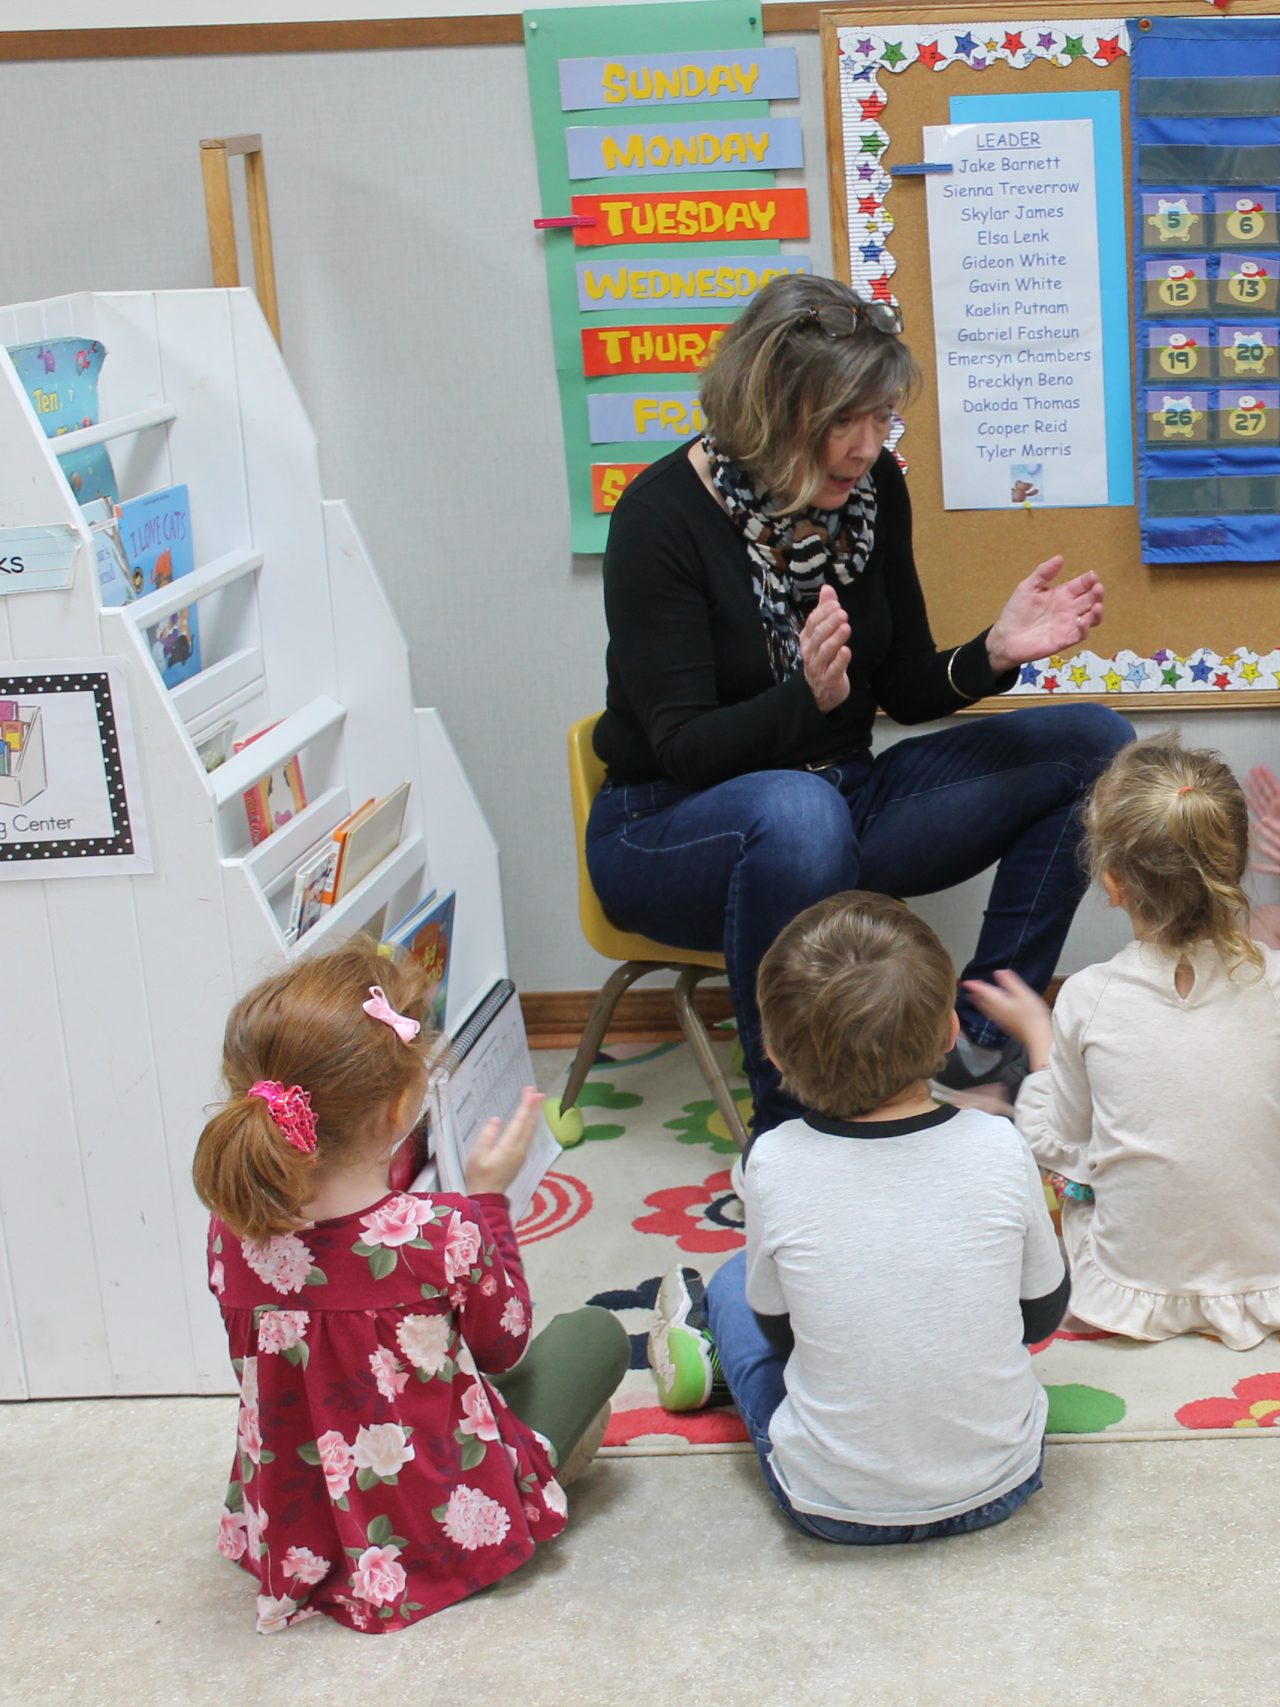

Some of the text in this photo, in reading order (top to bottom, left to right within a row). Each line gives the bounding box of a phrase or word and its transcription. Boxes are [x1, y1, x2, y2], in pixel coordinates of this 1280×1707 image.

[602, 63, 758, 103] SUNDAY
[977, 132, 1041, 149] LEADER
[601, 132, 769, 170] MONDAY
[959, 157, 1061, 174] Jake Barnett
[943, 182, 1080, 198] Sienna Treverrow
[600, 200, 776, 236] TUESDAY
[960, 206, 1064, 225] Skylar James
[1167, 211, 1181, 229] 5
[1240, 216, 1253, 234] 6
[978, 229, 1049, 245] Elsa Lenk
[962, 254, 1067, 270] Gideon White
[969, 278, 1063, 293] Gavin White
[1167, 283, 1189, 301] 12
[1238, 279, 1259, 298] 13
[965, 302, 1069, 317] Kaelin Putnam
[958, 326, 1079, 342] Gabriel Fasheun
[949, 350, 1091, 368] Emersyn Chambers
[1168, 352, 1189, 369] 19
[1237, 343, 1264, 361] 20
[968, 373, 1073, 390] Brecklyn Beno
[963, 397, 1080, 413] Dakoda Thomas
[978, 420, 1067, 438] Cooper Reid
[1165, 409, 1193, 426] 26
[1235, 413, 1262, 431] 27
[976, 444, 1071, 462] Tyler Morris
[163, 511, 186, 541] CATS
[13, 814, 75, 832] Center
